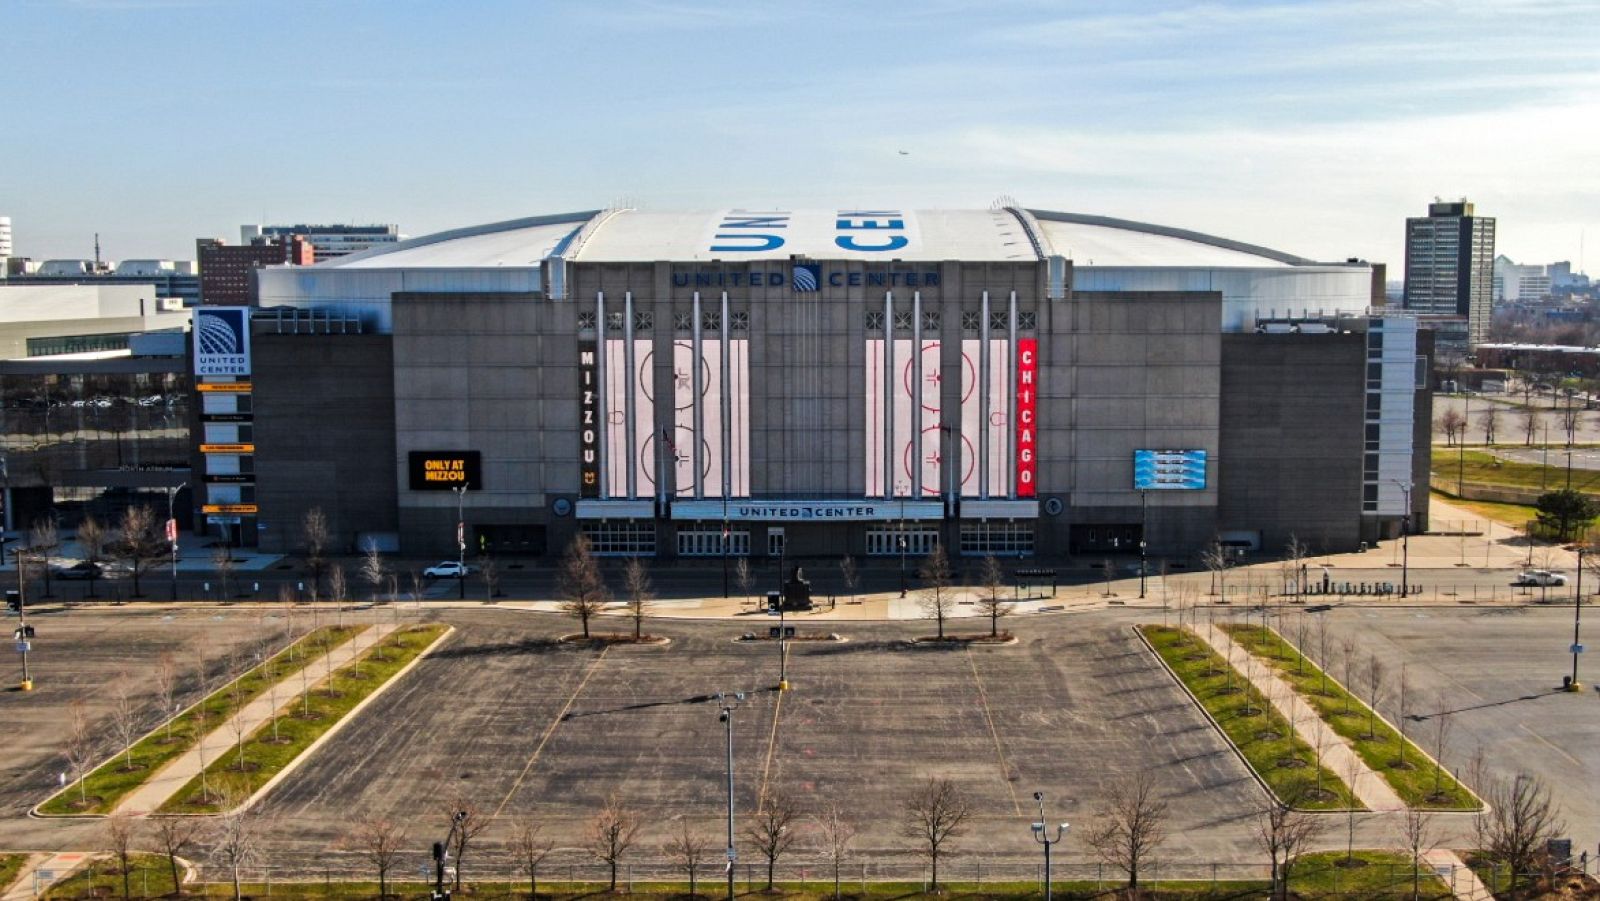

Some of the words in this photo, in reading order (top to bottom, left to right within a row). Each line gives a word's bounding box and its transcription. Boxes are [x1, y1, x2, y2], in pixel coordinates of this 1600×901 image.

[709, 208, 792, 251] UNI
[672, 271, 785, 287] UNITED
[828, 271, 940, 287] CENTER
[199, 366, 245, 374] CENTER
[581, 351, 595, 464] MIZZOU
[1021, 350, 1033, 484] CHICAGO
[424, 459, 450, 471] ONLY
[451, 459, 465, 471] AT
[424, 471, 465, 482] MIZZOU
[740, 507, 799, 517] UNITED
[815, 507, 874, 517] CENTER
